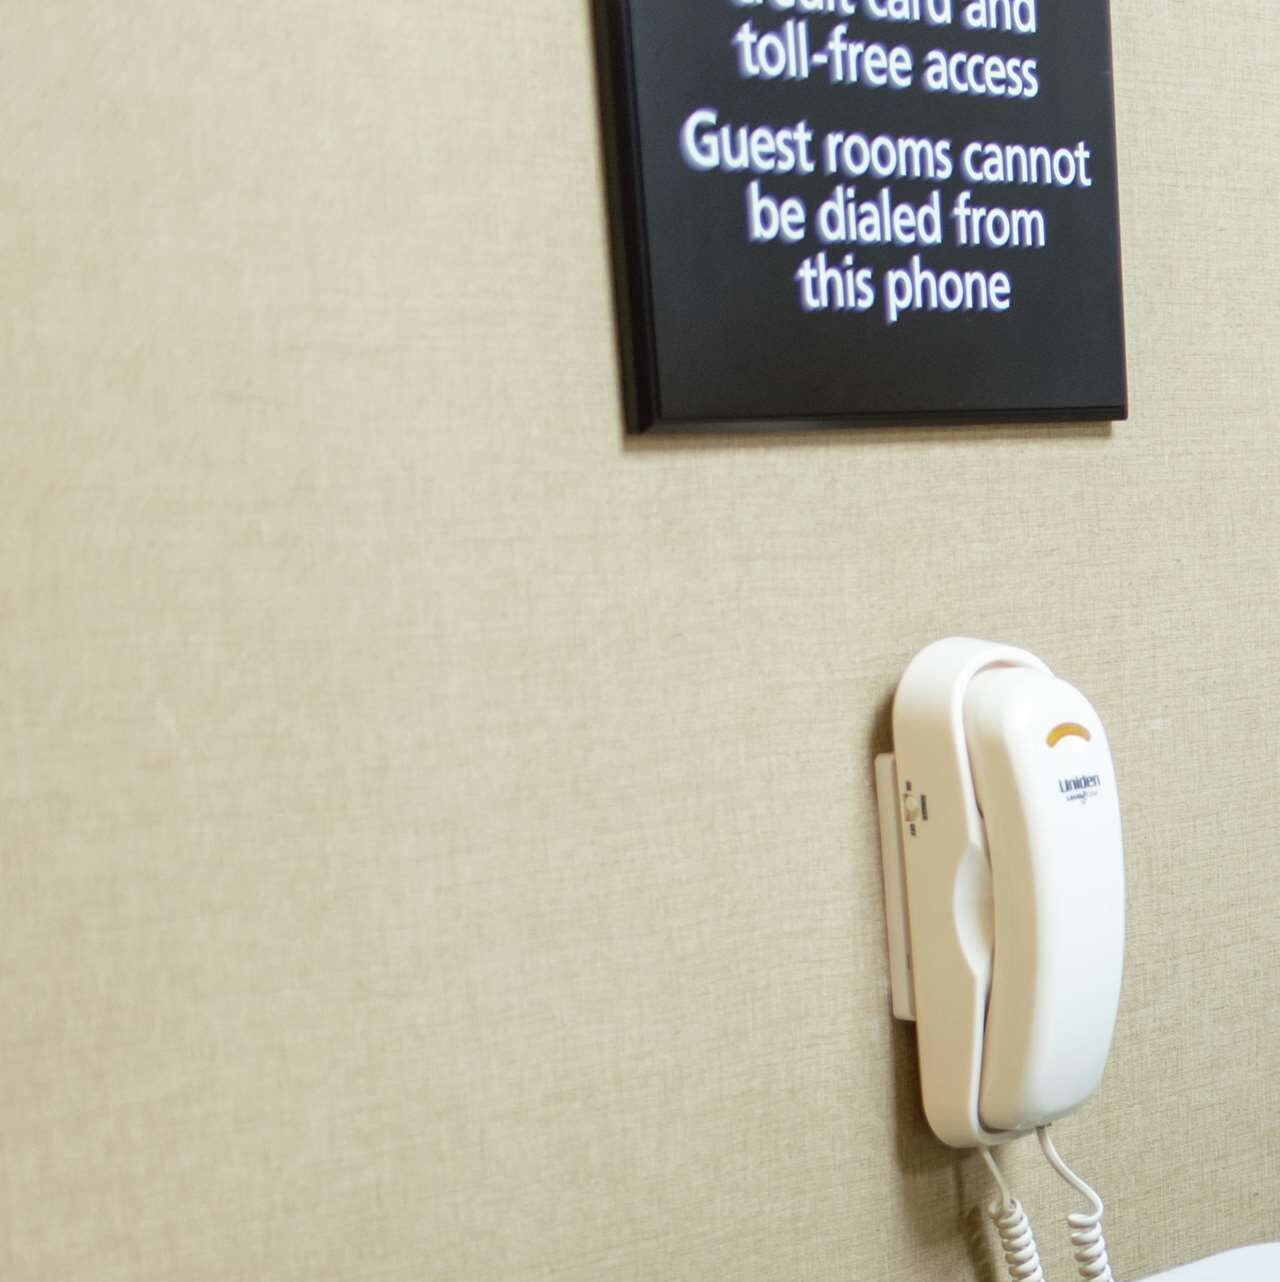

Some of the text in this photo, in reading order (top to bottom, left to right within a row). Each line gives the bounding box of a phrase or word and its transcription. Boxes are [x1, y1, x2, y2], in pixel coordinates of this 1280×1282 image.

[963, 0, 1037, 33] and
[733, 17, 1039, 98] toll-free access
[682, 108, 1092, 188] Guest rooms cannot
[746, 178, 1046, 248] be dialed from
[796, 250, 1012, 324] this phone
[1058, 774, 1101, 793] Uniden
